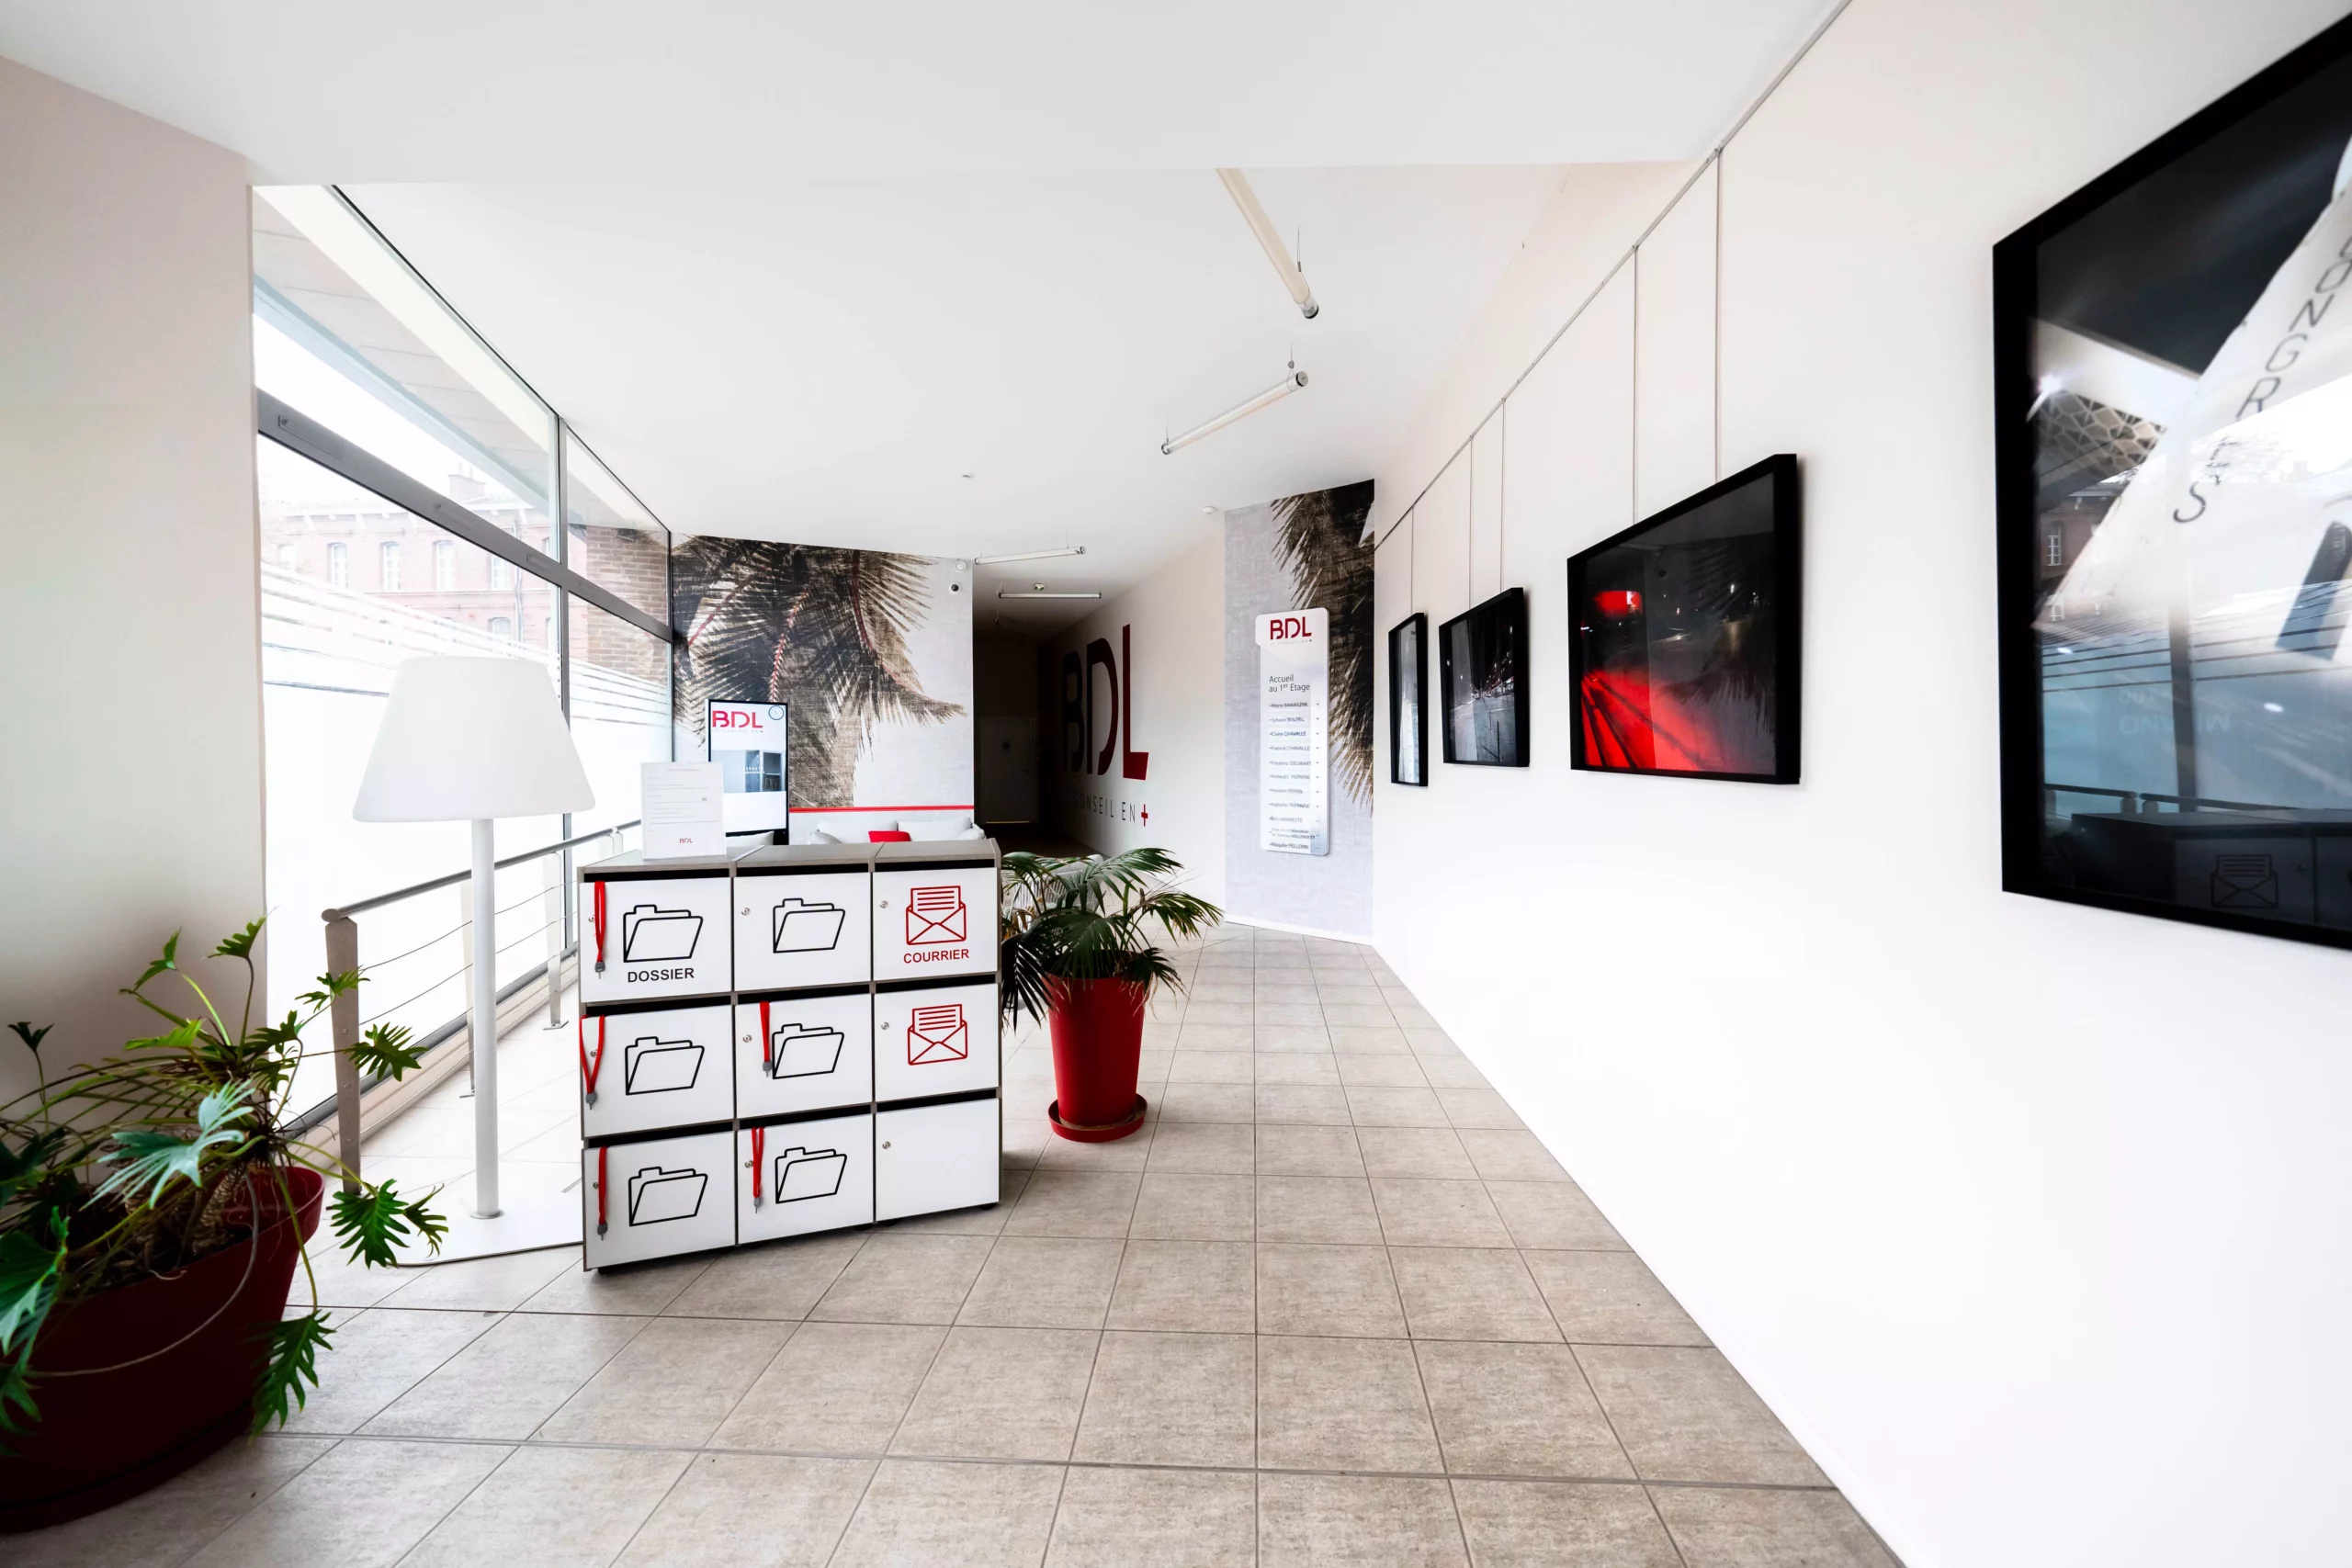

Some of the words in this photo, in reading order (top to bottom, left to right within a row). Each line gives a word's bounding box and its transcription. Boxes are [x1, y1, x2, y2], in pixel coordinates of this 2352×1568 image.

[1270, 616, 1312, 640] BDL
[1269, 674, 1294, 682] Accueil
[1290, 683, 1310, 693] Etage
[1063, 624, 1149, 781] BDL
[712, 710, 763, 728] BDL
[1122, 802, 1136, 823] EN
[903, 949, 969, 964] COURRIER
[628, 967, 695, 983] DOSSIER
